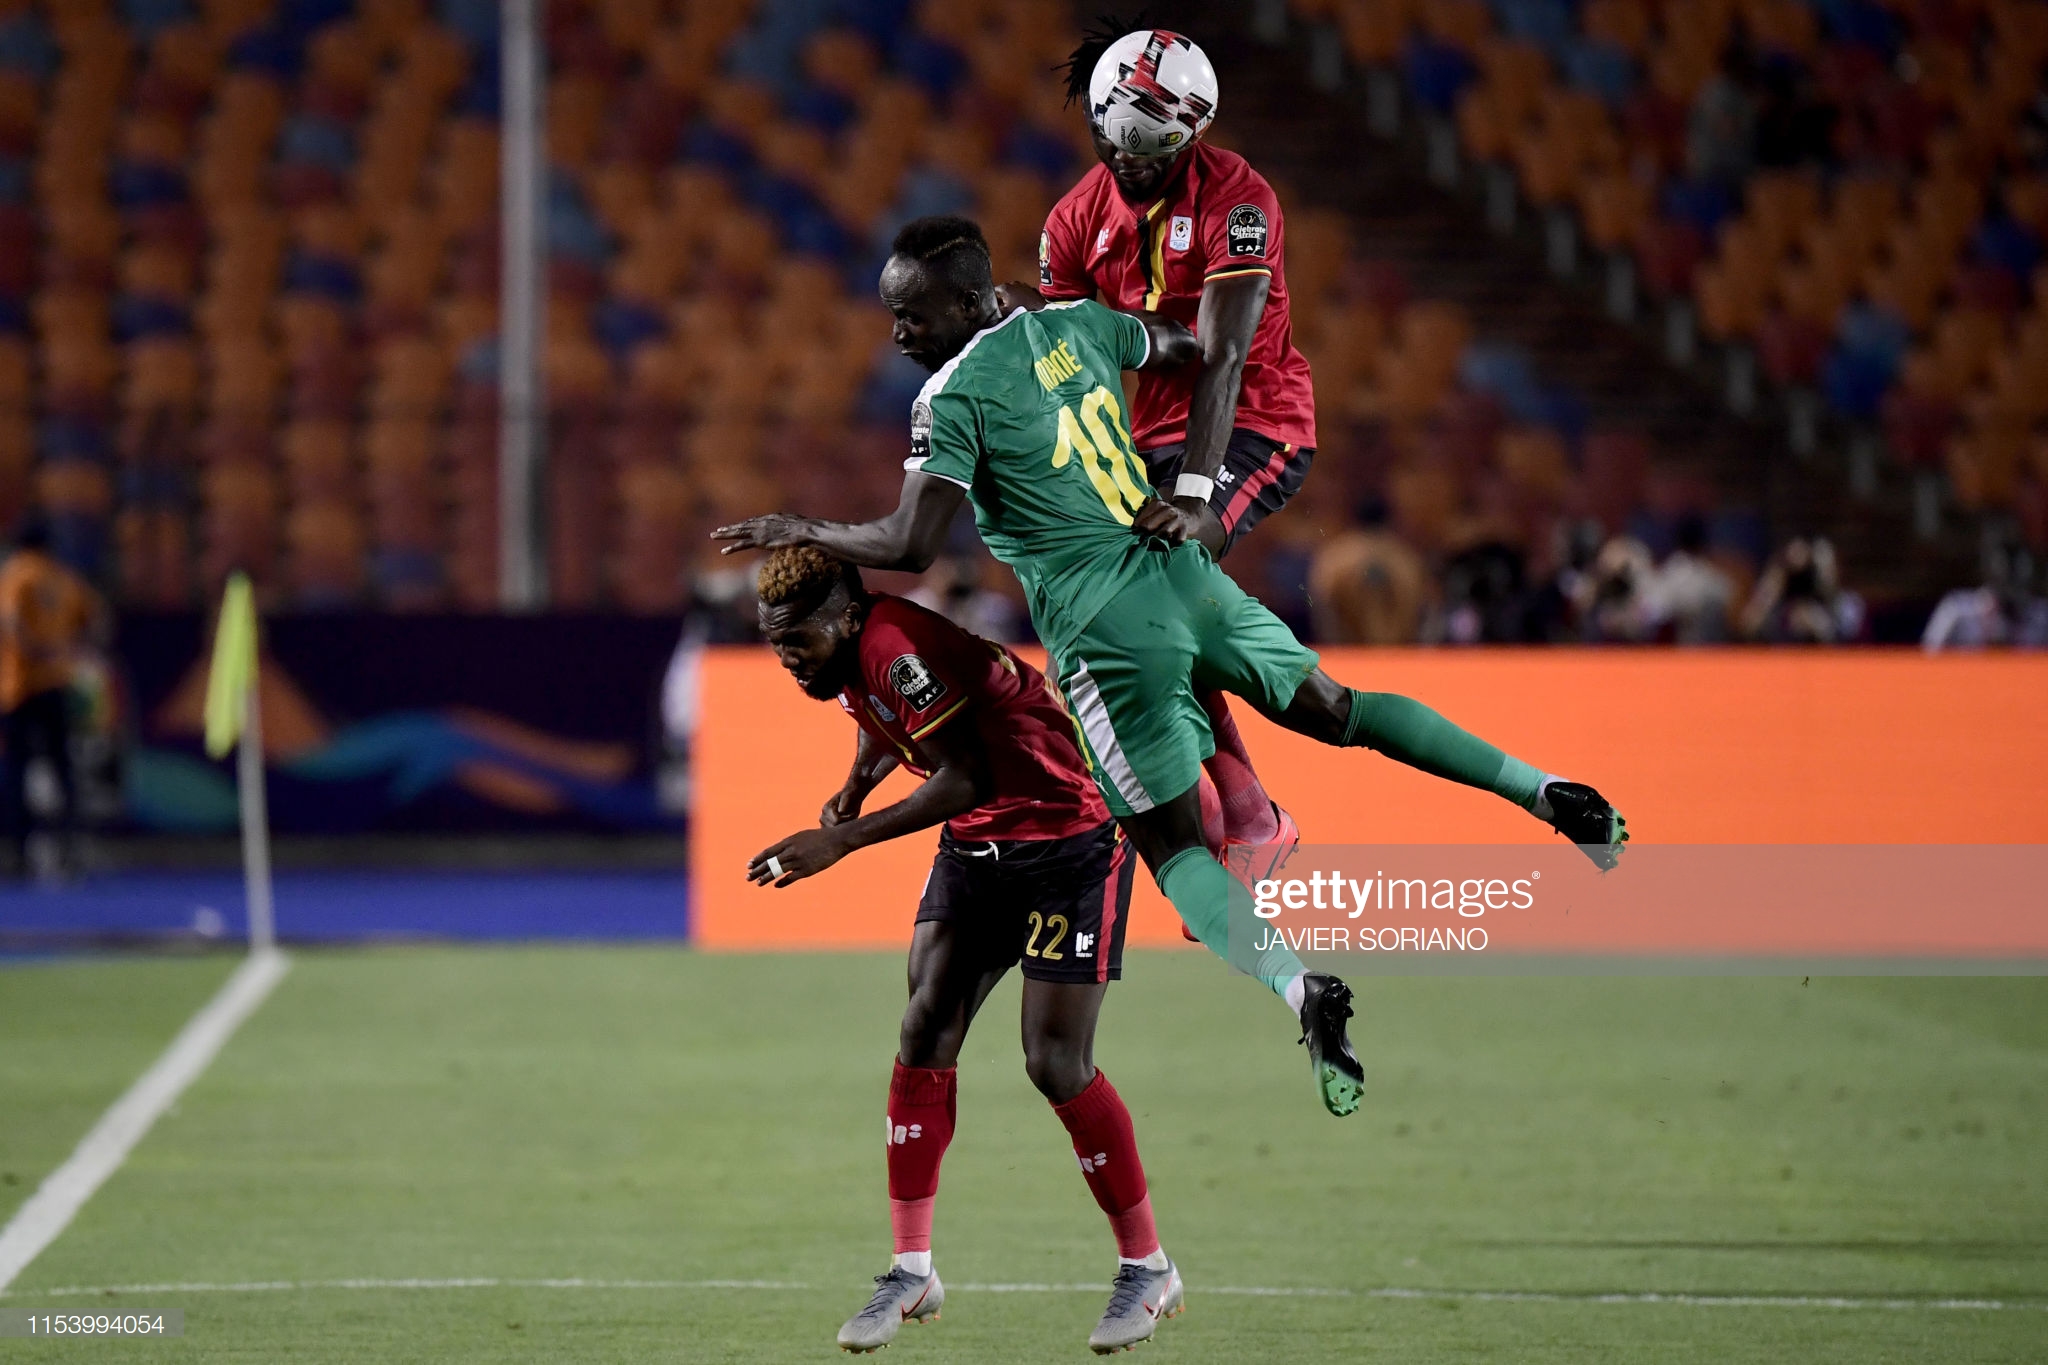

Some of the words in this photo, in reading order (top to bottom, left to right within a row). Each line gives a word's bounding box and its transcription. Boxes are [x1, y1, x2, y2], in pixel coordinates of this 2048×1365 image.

[1230, 224, 1266, 236] Celebrate
[1235, 230, 1260, 239] Africa
[1236, 244, 1261, 253] CAF
[1051, 385, 1149, 527] 10
[900, 669, 929, 695] Celebra
[918, 686, 938, 705] CAF
[1026, 911, 1068, 960] 22
